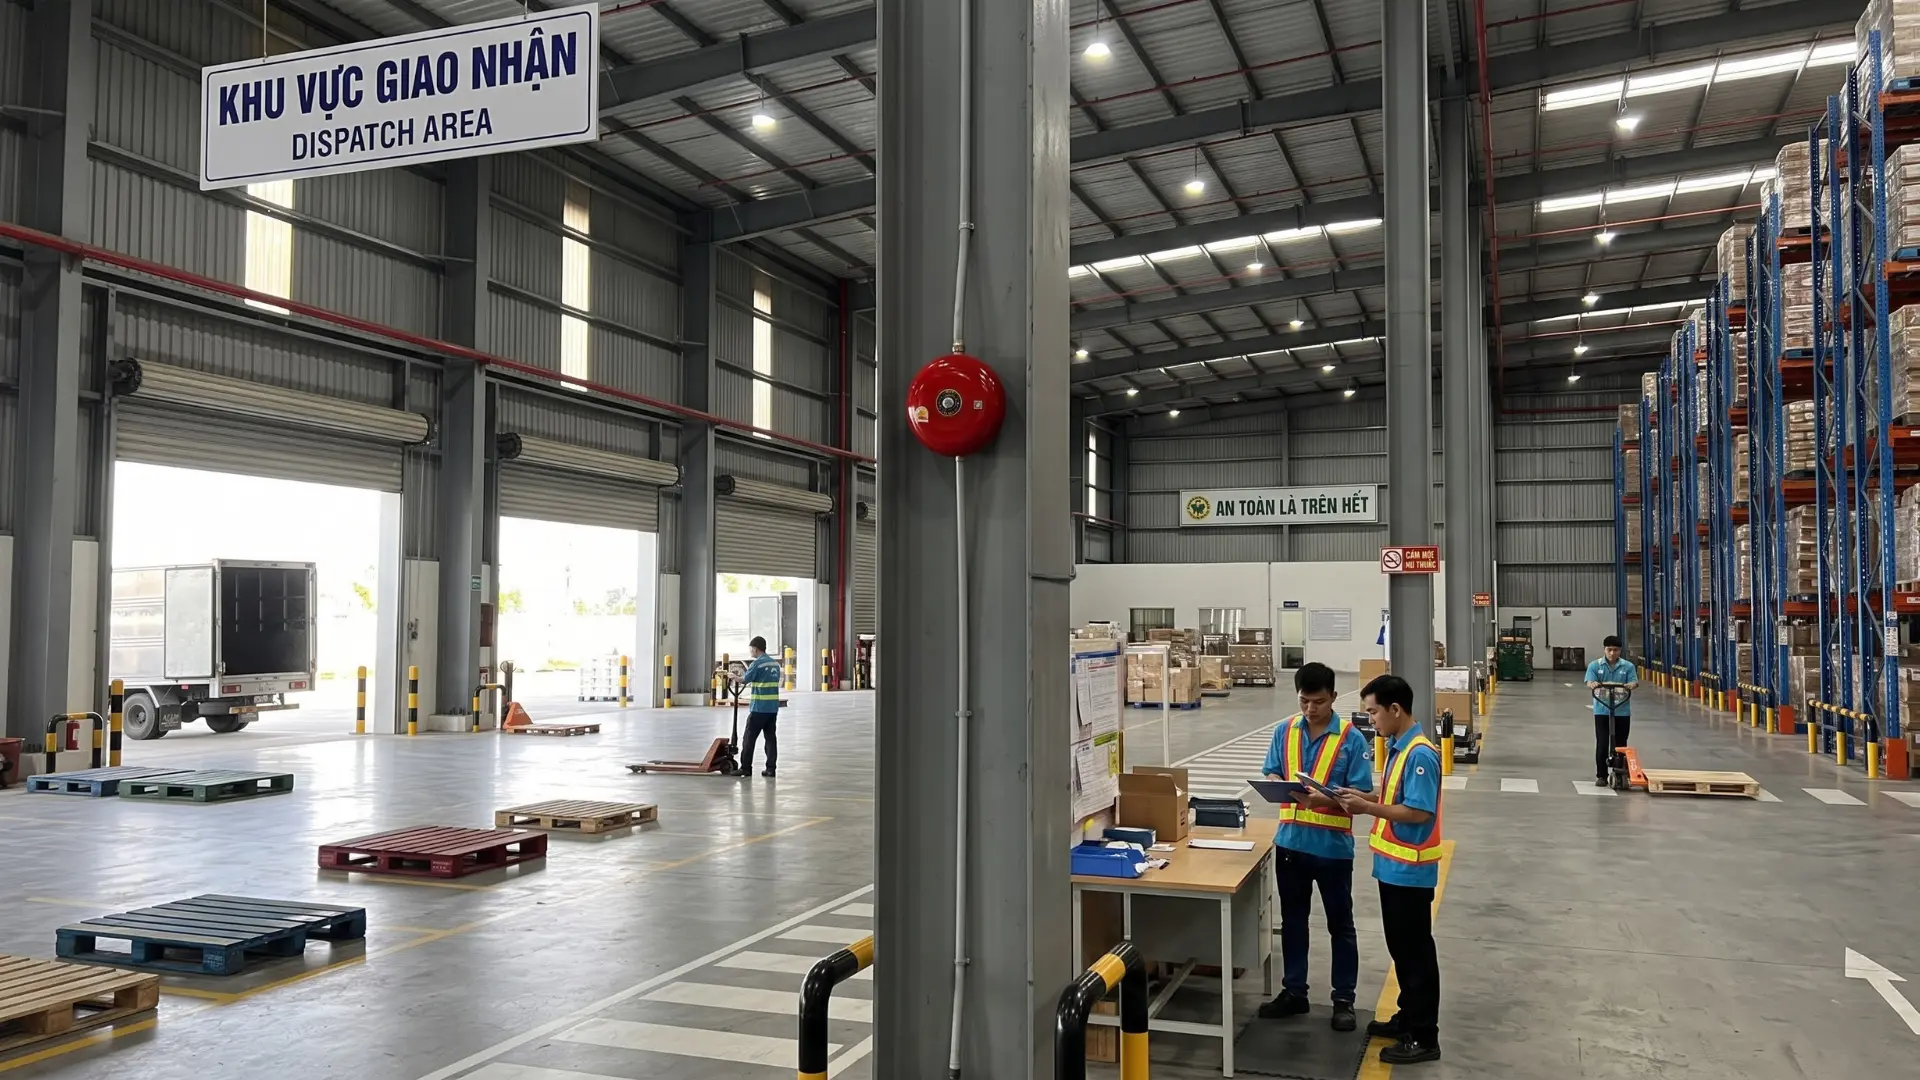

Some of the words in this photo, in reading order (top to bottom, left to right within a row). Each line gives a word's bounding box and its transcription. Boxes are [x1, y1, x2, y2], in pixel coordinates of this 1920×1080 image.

[219, 77, 285, 126] KHU
[297, 64, 363, 121] VỰC
[376, 51, 458, 105] GIAO
[472, 27, 577, 92] NHẬN
[292, 118, 415, 161] DISPATCH
[423, 107, 493, 144] AREA
[1216, 500, 1235, 516] AN
[1239, 495, 1275, 516] TOÀN
[1280, 494, 1297, 515] LÀ
[1301, 493, 1337, 514] TRÊN
[1342, 489, 1369, 513] HẾT
